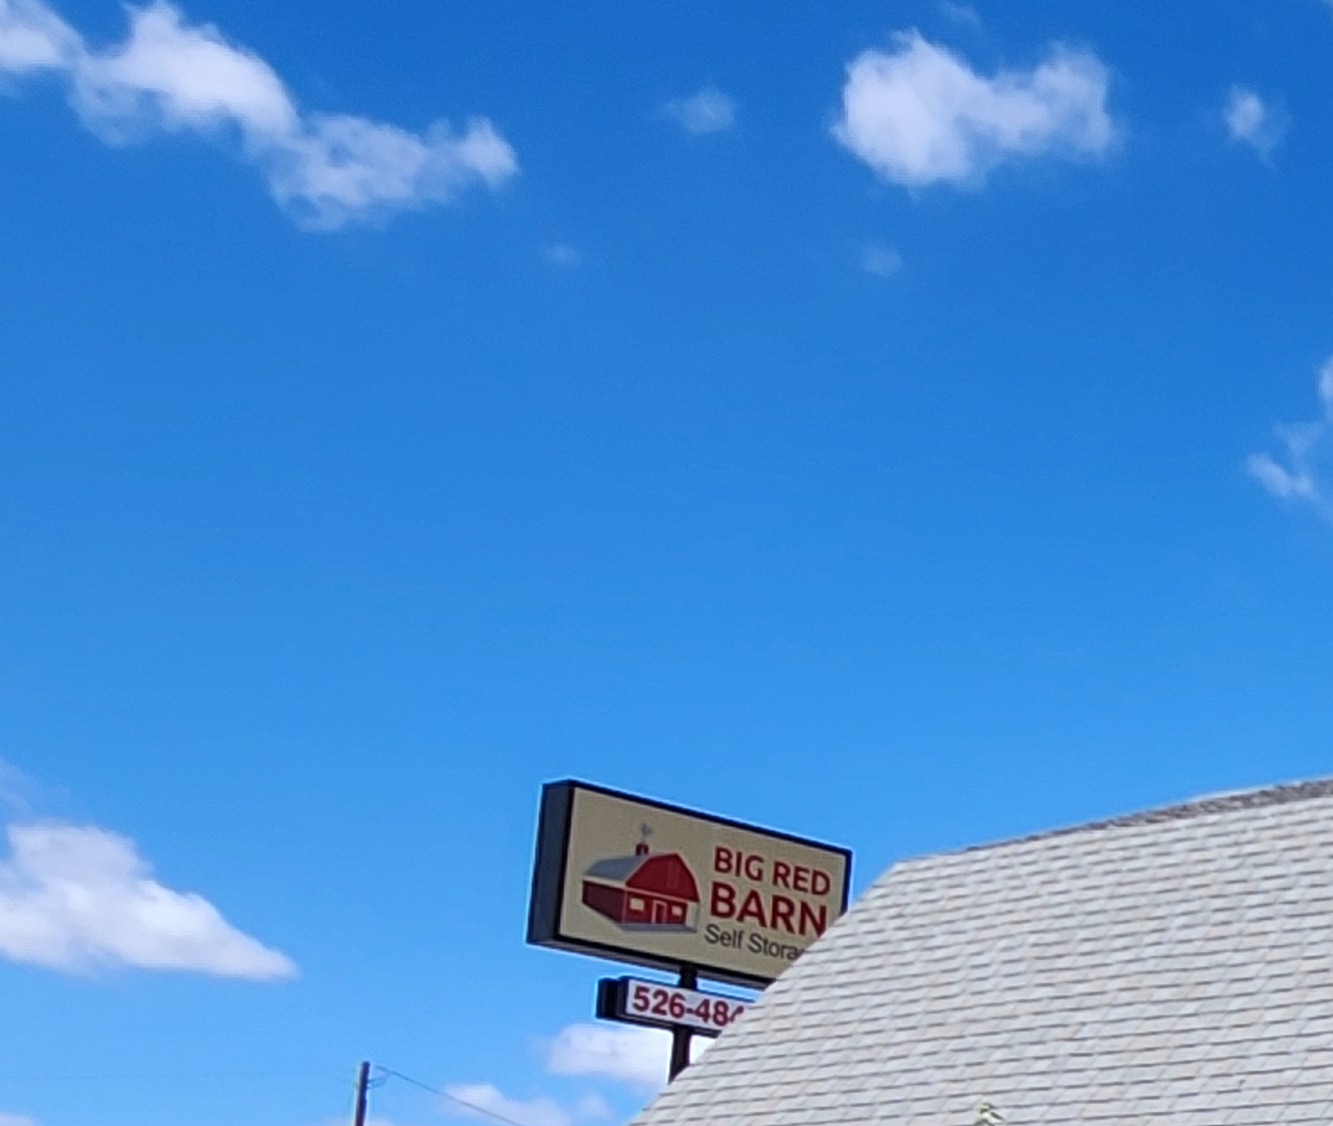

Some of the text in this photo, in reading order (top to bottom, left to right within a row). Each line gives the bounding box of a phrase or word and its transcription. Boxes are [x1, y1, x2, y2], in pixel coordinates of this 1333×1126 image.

[714, 847, 831, 895] BIG RED
[710, 881, 827, 938] BARN
[704, 923, 805, 960] Self Stora
